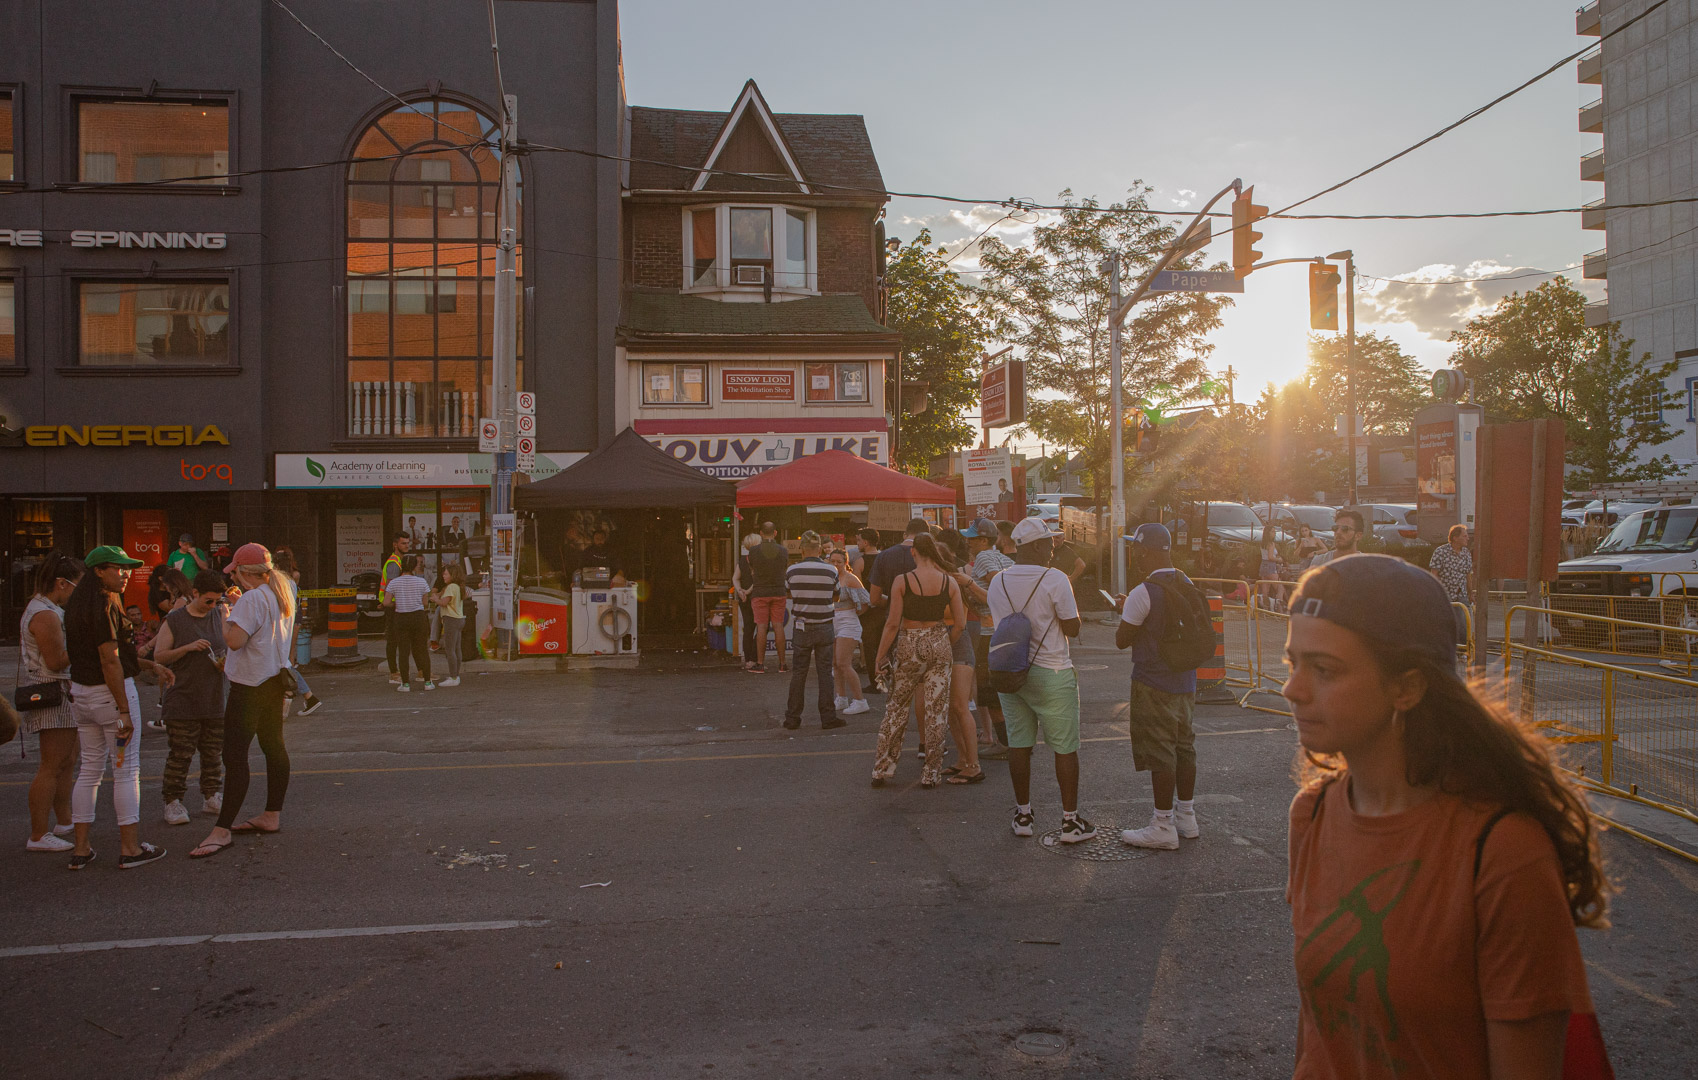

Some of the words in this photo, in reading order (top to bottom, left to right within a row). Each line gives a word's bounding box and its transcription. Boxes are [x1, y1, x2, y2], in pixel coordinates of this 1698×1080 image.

[70, 230, 227, 249] SPINNING
[1171, 273, 1208, 289] Pape
[774, 386, 791, 395] Shop
[25, 424, 231, 447] ENERGIA
[792, 436, 880, 461] LIKE
[181, 459, 233, 485] torq
[330, 461, 374, 472] Academy
[375, 461, 385, 471] of
[386, 461, 426, 471] Learning
[135, 541, 160, 554] torq
[525, 617, 557, 635] Breyers
